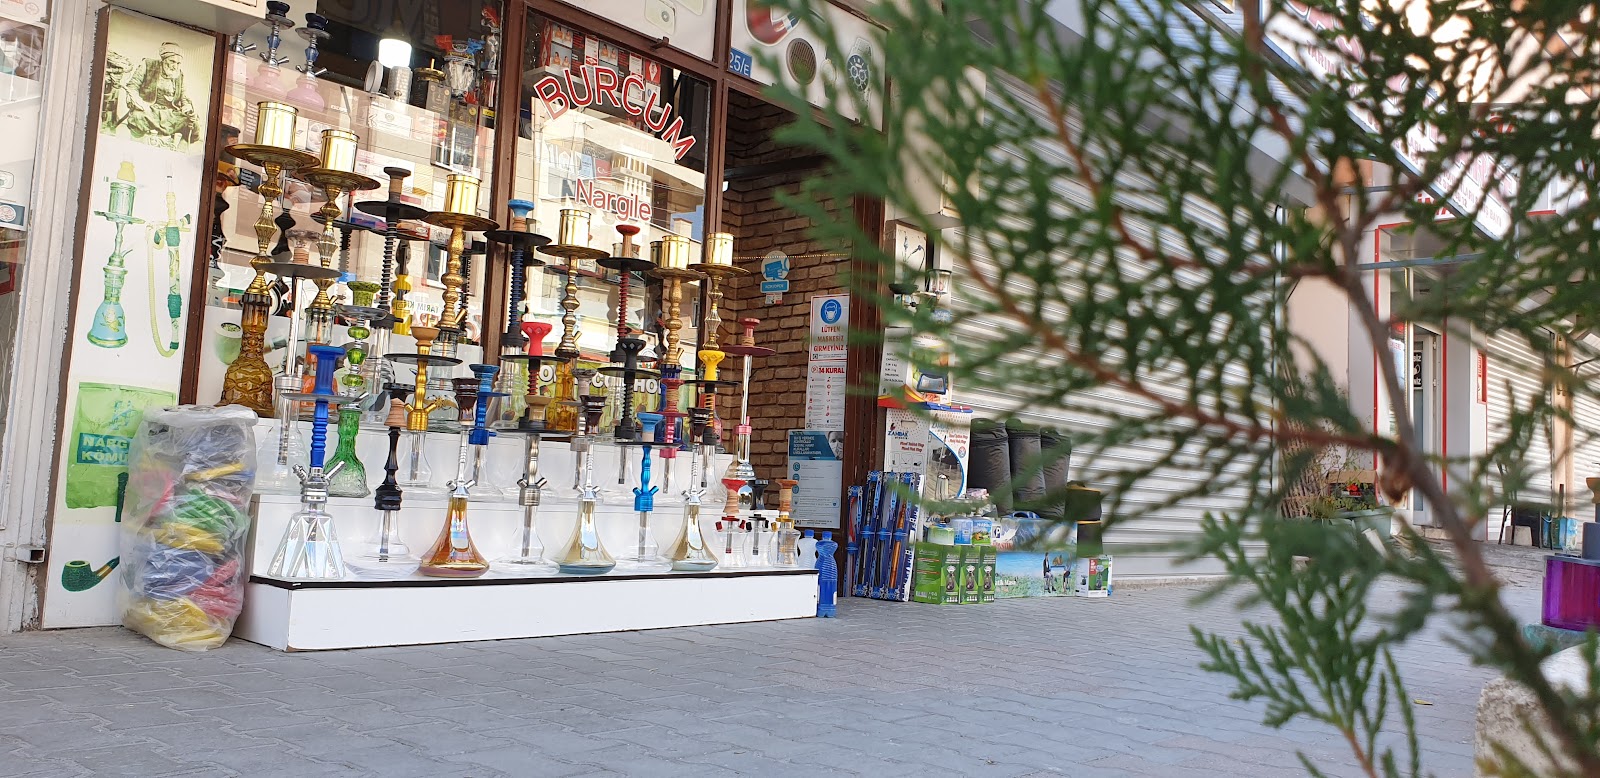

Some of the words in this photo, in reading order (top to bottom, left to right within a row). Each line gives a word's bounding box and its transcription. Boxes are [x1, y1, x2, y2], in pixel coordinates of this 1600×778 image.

[533, 65, 697, 160] BURCUM
[575, 177, 652, 221] Nargile
[82, 436, 128, 448] NARG
